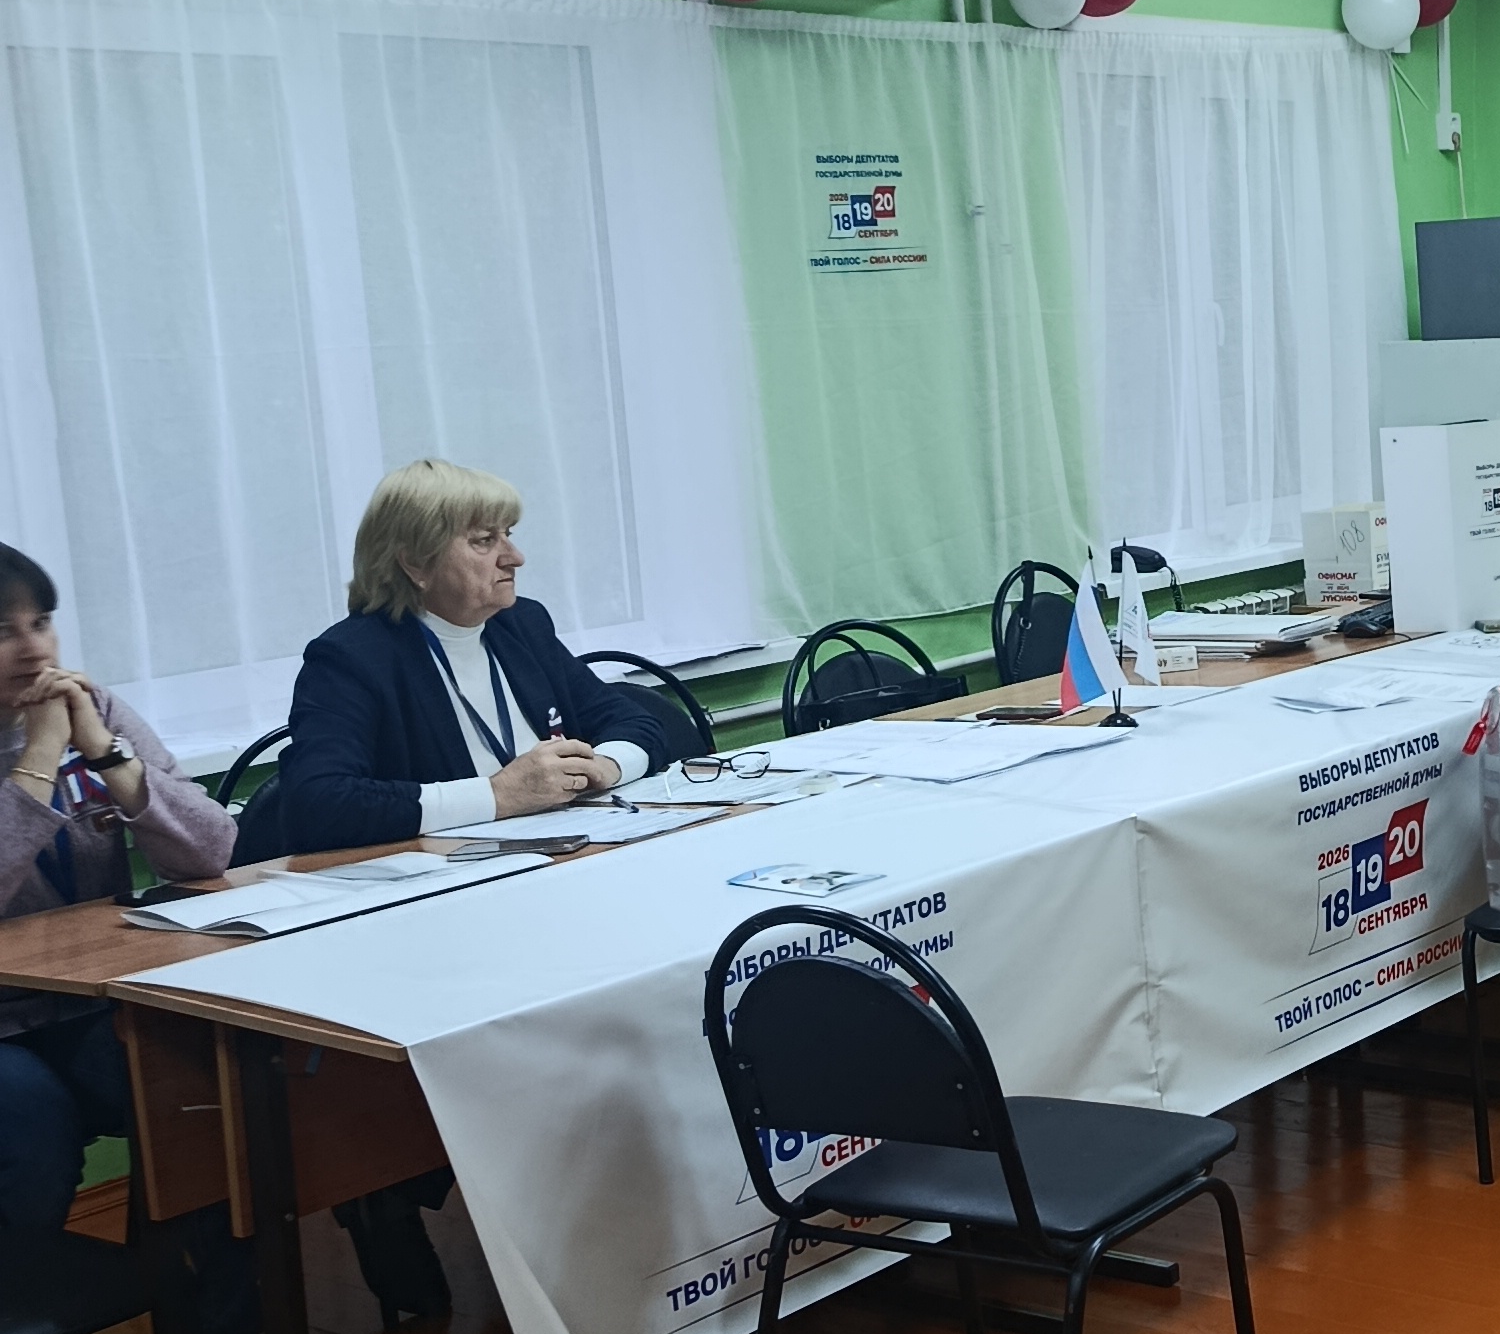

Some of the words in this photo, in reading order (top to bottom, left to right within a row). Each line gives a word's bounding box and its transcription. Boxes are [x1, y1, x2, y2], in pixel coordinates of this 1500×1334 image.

[816, 155, 853, 164] ВЫБОРЫ
[855, 155, 899, 164] ДЕПУТАТОВ
[853, 202, 872, 221] 19
[874, 193, 894, 211] 20
[834, 213, 852, 231] 18
[858, 229, 898, 238] СЕНТЯБРЯ
[810, 256, 831, 267] ТВОЙ
[832, 256, 861, 266] ГОЛОС
[869, 256, 891, 265] СИЛА
[1484, 500, 1494, 512] 18
[1340, 520, 1365, 556] 108
[1318, 572, 1358, 580] ОФИСМАГ
[1299, 758, 1362, 793] ВЫБОРЫ
[1364, 732, 1440, 775] ДЕПУТАТОВ
[1297, 771, 1410, 826] ГОСУДАРСТВЕННОЙ
[1411, 763, 1443, 789] ДУМЫ
[1317, 844, 1350, 871] 2026
[1389, 820, 1420, 866] 20
[1356, 853, 1383, 897] 19
[1321, 888, 1350, 932] 18
[1358, 893, 1428, 935] СЕНТЯБРЯ
[909, 931, 954, 959] УМЫ
[705, 937, 811, 987] ЫБОРЫ
[1274, 996, 1313, 1033] ТВОЙ
[1316, 979, 1362, 1014] ГОЛОС
[1377, 957, 1414, 986] СИЛА
[666, 1257, 737, 1312] ТВОЙ
